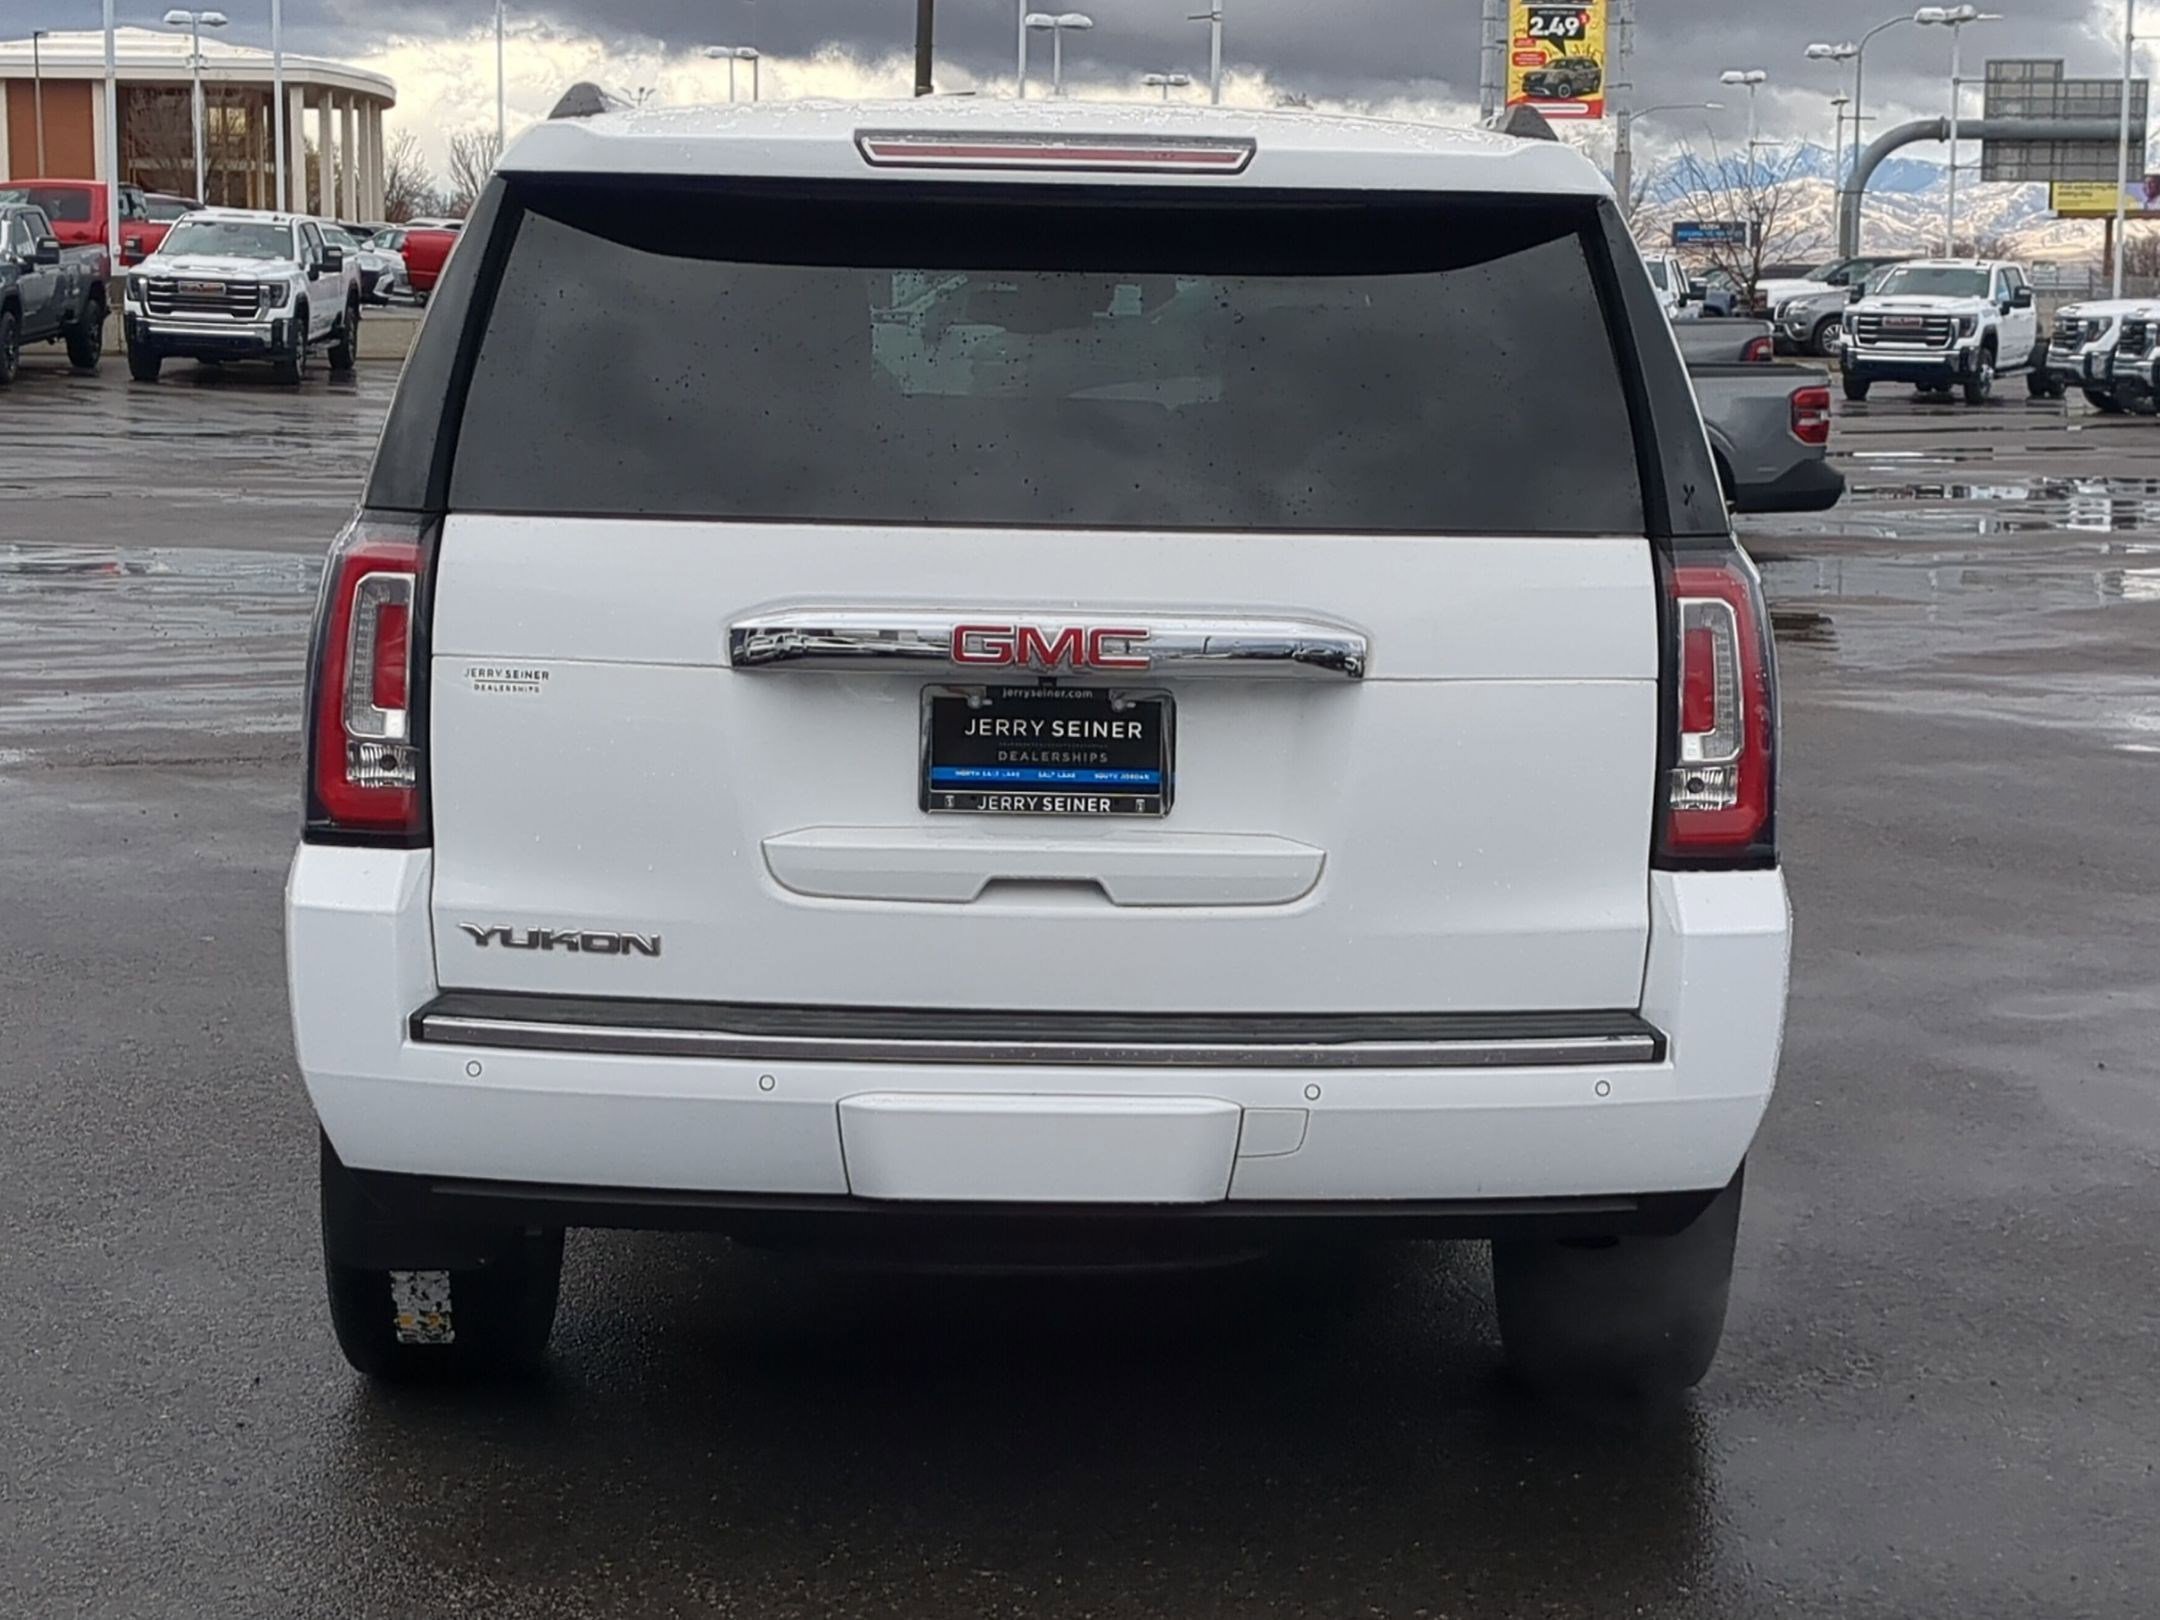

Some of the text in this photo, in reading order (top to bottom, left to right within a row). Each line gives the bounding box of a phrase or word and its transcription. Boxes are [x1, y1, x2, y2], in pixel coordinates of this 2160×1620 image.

[1529, 16, 1580, 37] 2.49
[952, 624, 1150, 670] GMC
[464, 668, 549, 680] JERRY SEINER
[474, 684, 540, 693] DEALERSHIPS
[1002, 687, 1093, 699] jerryseiner.com
[964, 718, 1143, 739] JERRY SEINER
[998, 750, 1108, 763] DEALERSHIPS
[977, 795, 1111, 812] JERRY SEINER
[458, 921, 661, 957] YUKON
